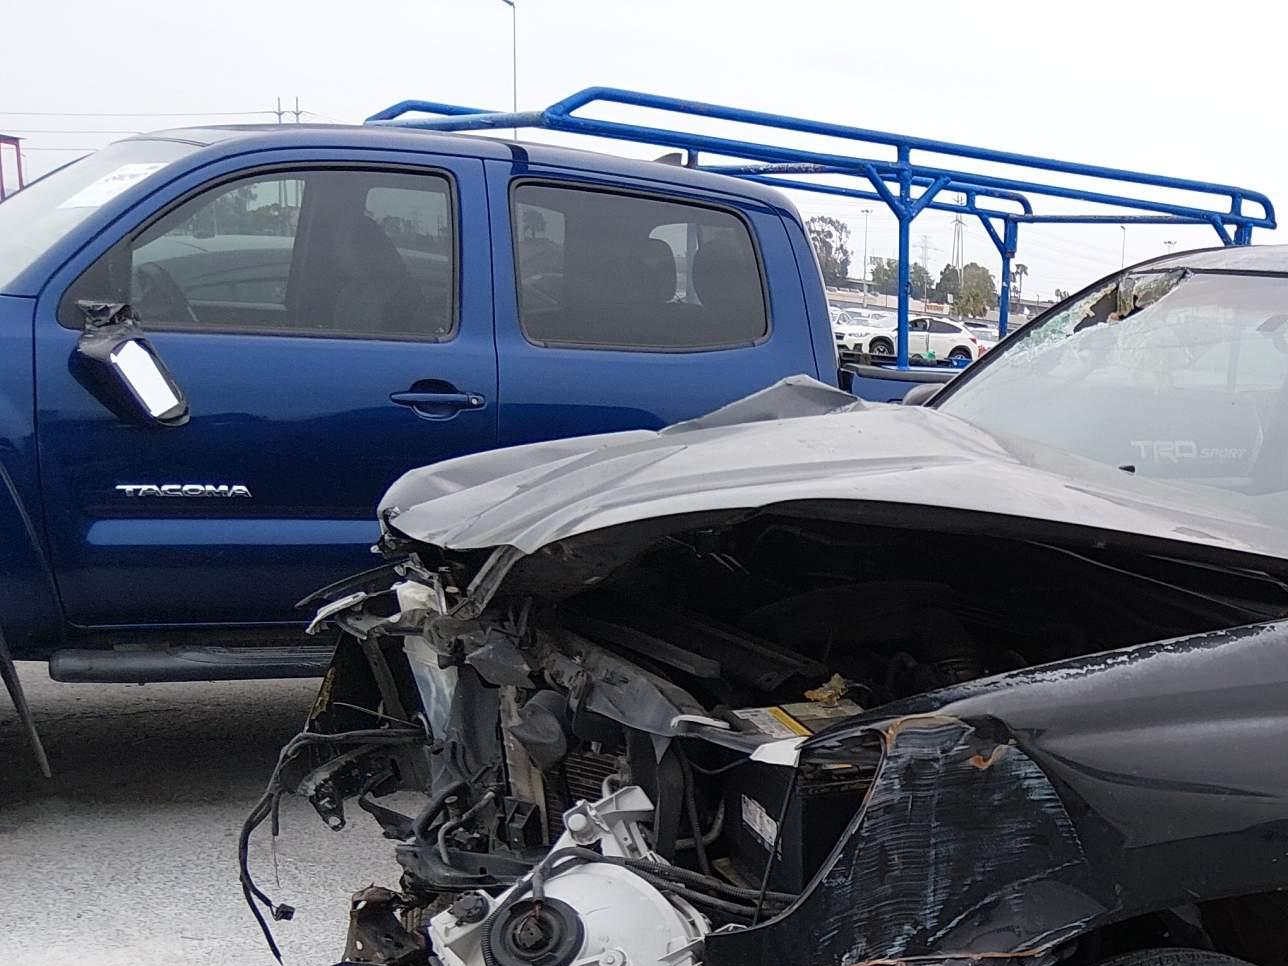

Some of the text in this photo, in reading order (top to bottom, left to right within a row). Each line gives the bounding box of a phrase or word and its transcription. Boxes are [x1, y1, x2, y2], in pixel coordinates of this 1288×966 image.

[1130, 440, 1247, 463] TRD SPORT
[115, 484, 253, 498] TACOMA
